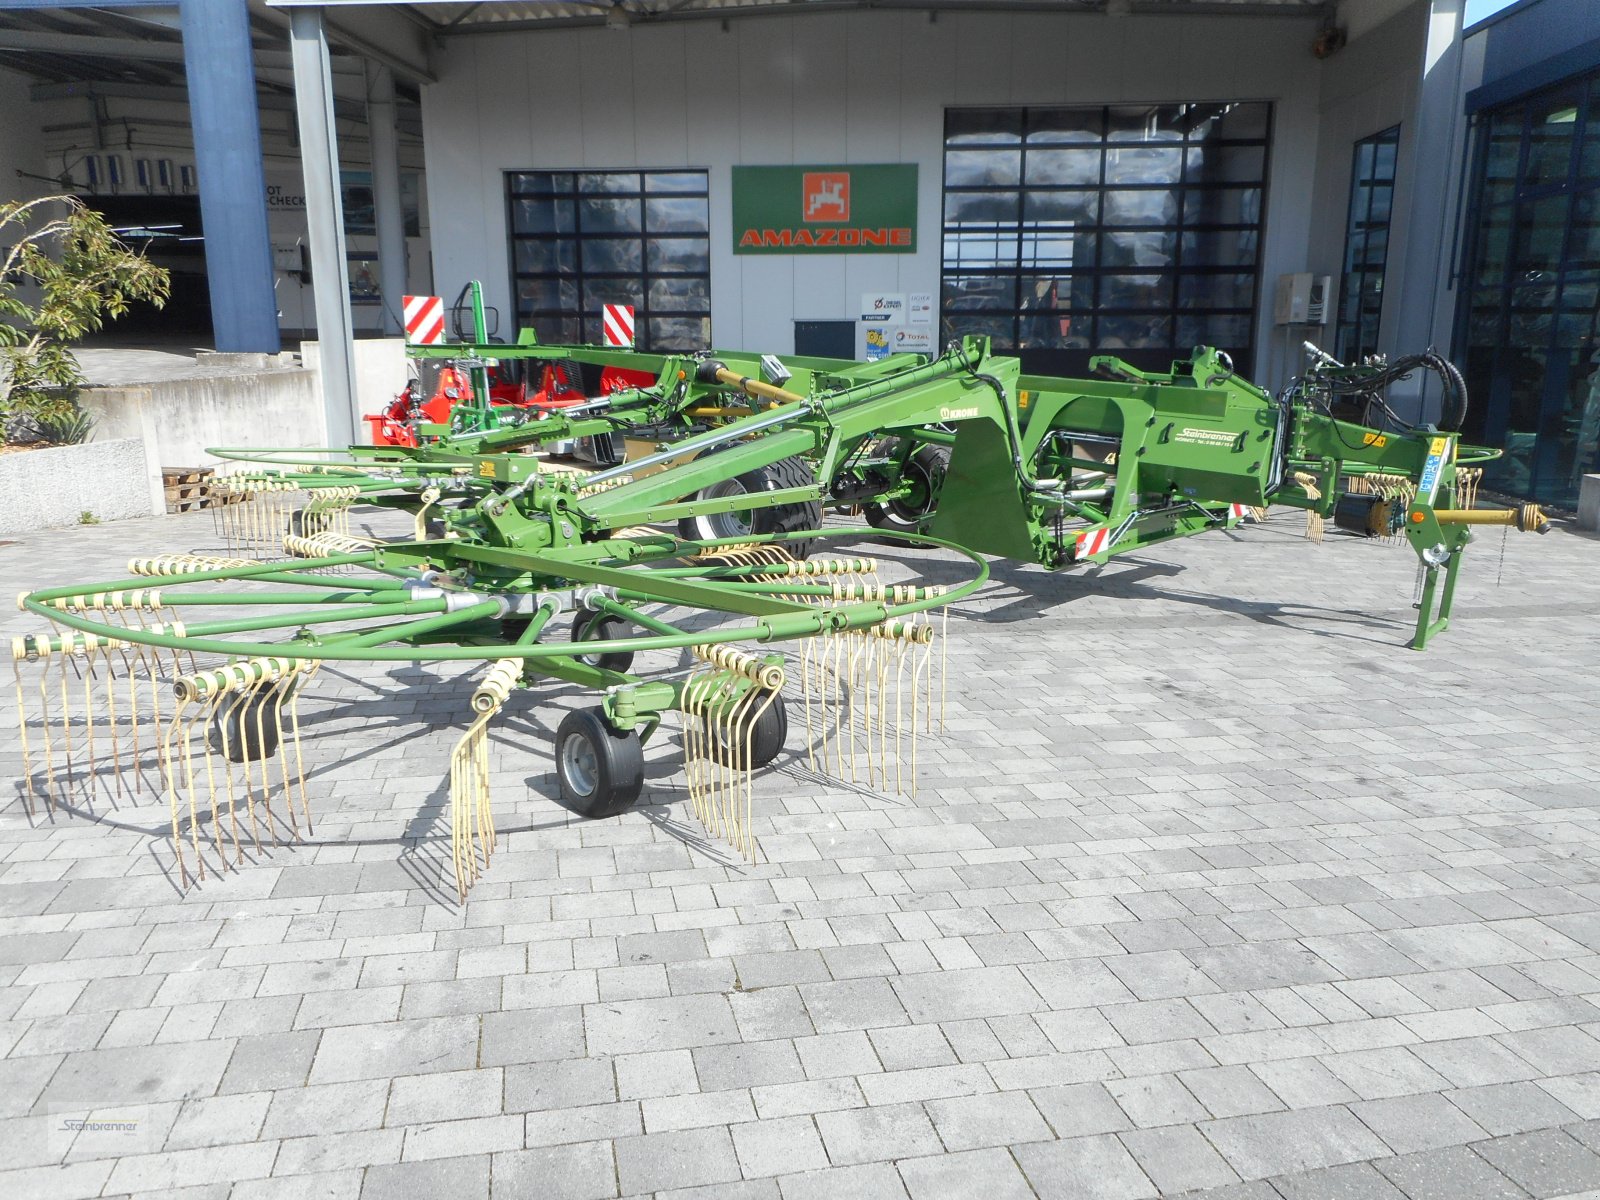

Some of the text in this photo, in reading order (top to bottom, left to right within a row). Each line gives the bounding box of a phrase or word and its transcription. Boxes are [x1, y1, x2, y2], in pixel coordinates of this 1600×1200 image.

[739, 228, 912, 247] AMAZONE
[950, 408, 978, 418] KRONE
[1177, 428, 1237, 443] Steinbrenner
